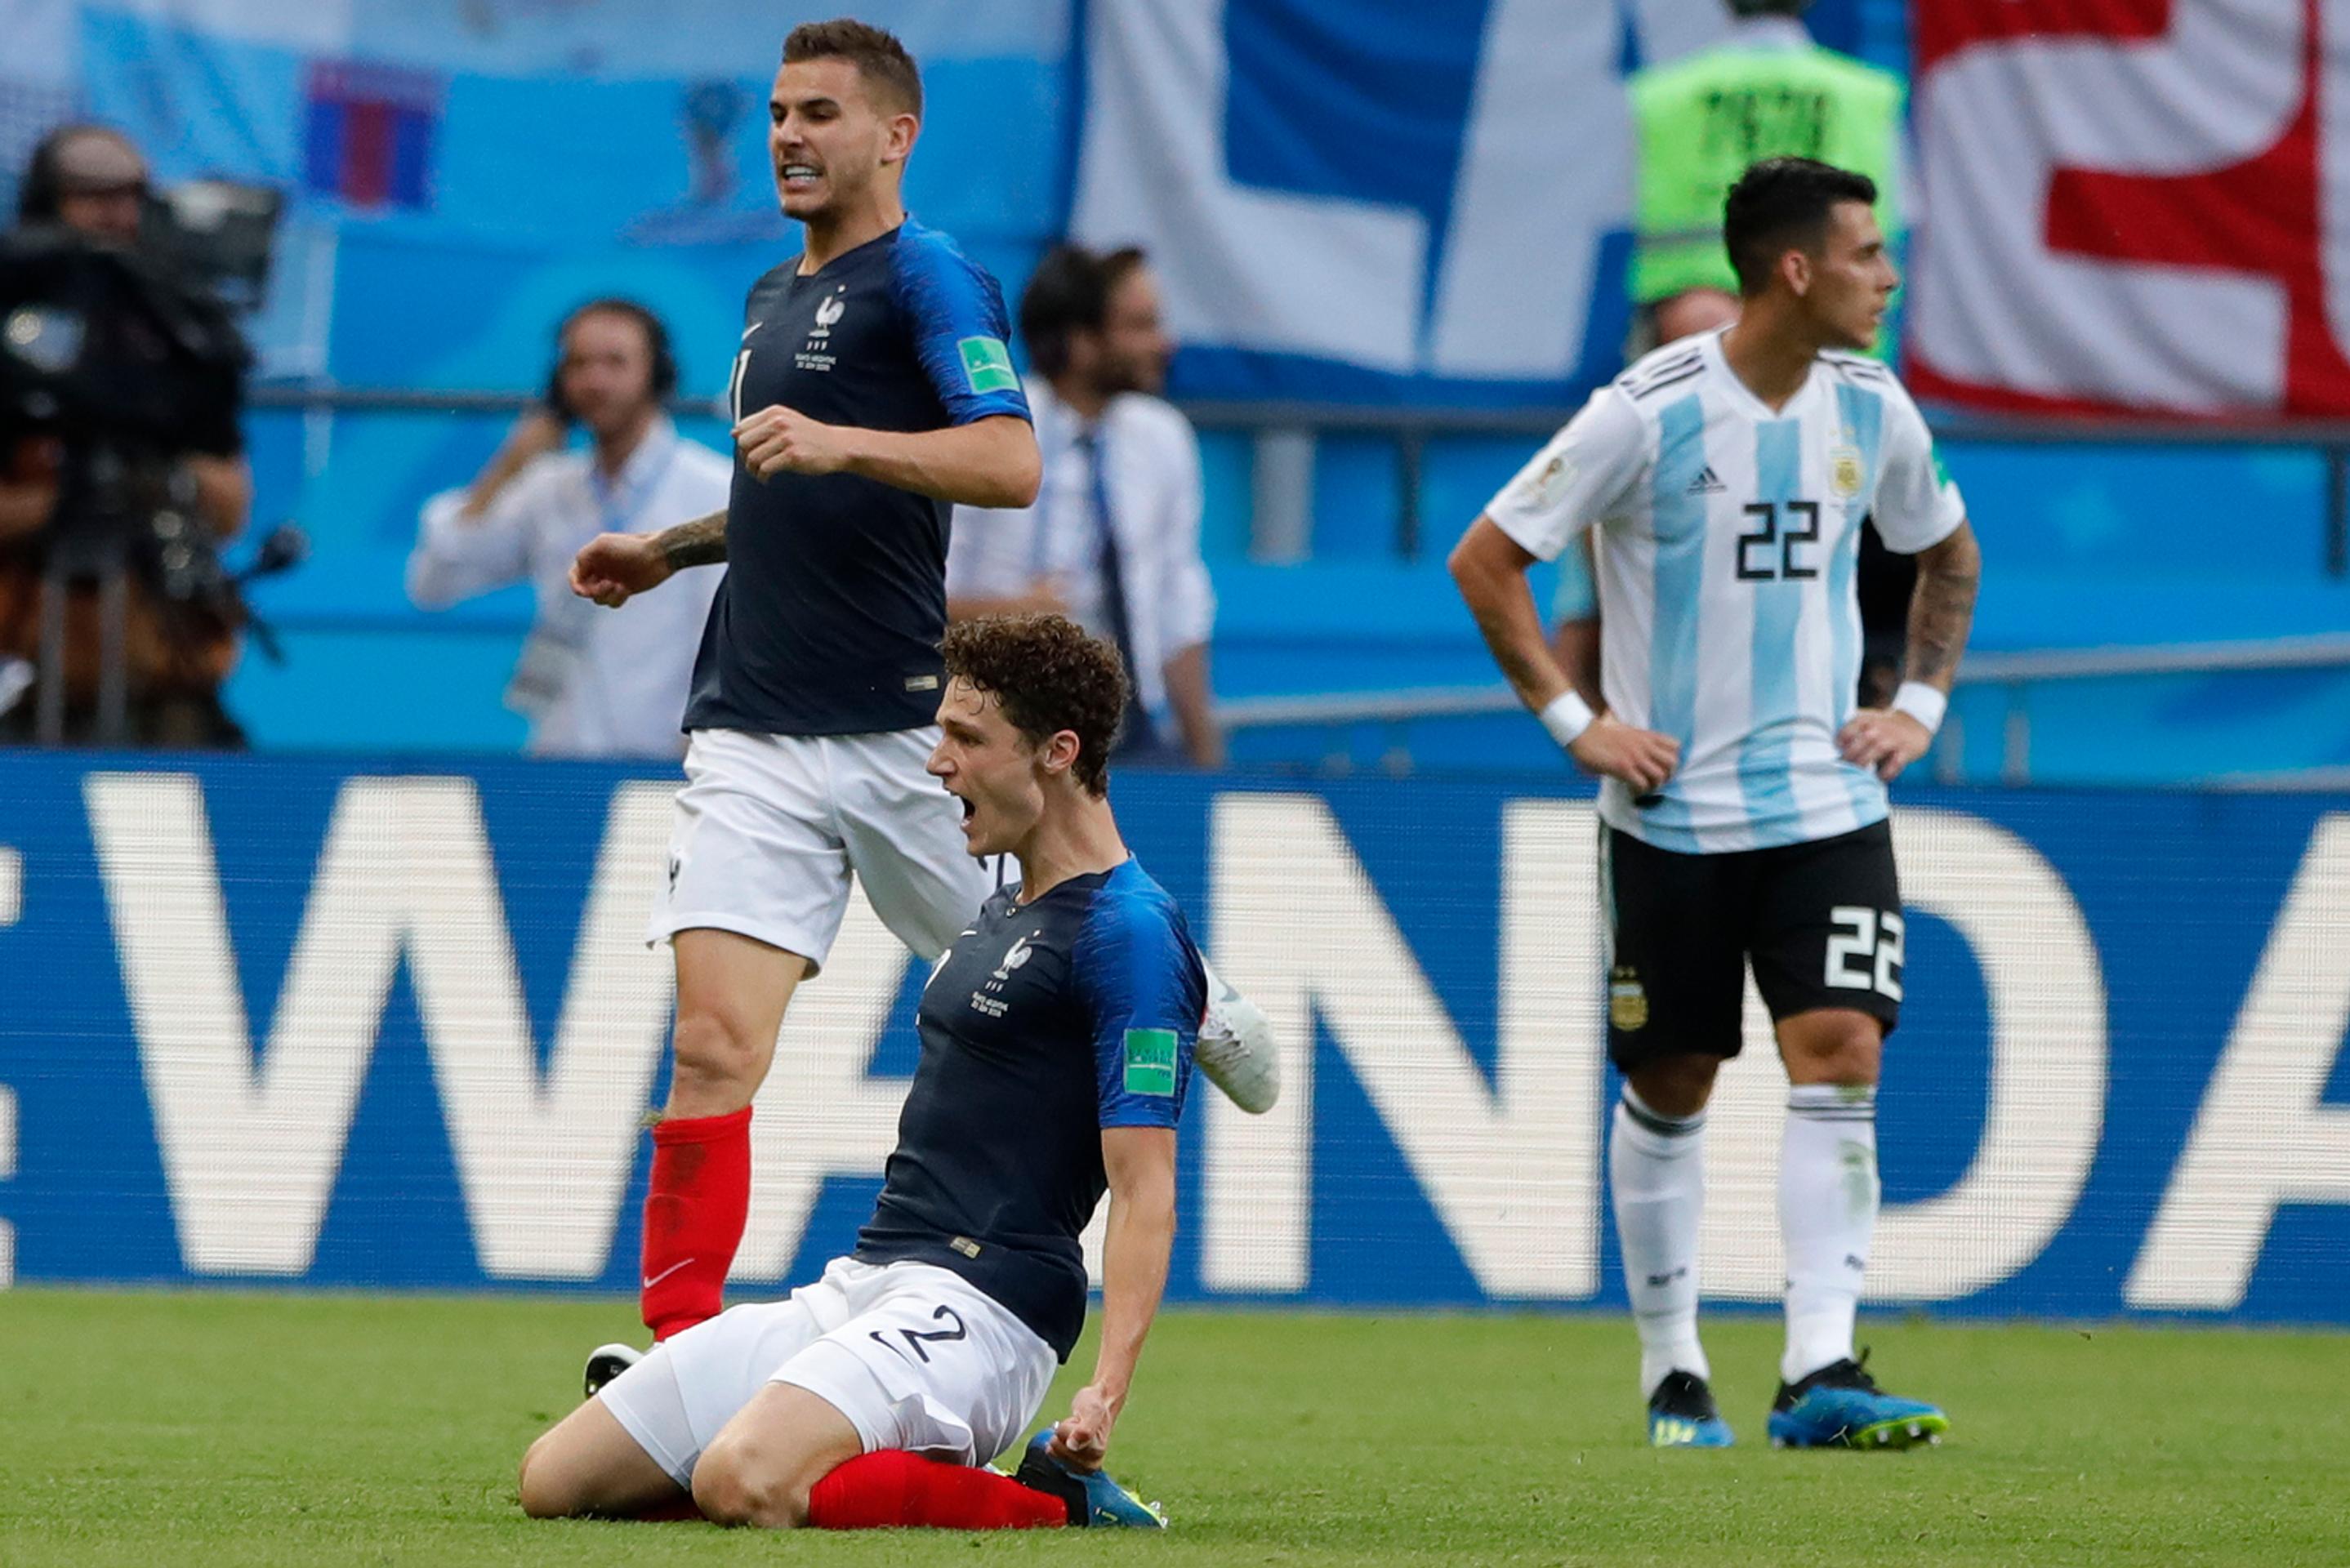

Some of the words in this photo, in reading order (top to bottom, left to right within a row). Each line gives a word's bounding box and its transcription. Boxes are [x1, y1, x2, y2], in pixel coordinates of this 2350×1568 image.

[1735, 501, 1820, 580] 22
[1824, 905, 1905, 1004] 22
[898, 1304, 966, 1364] 2
